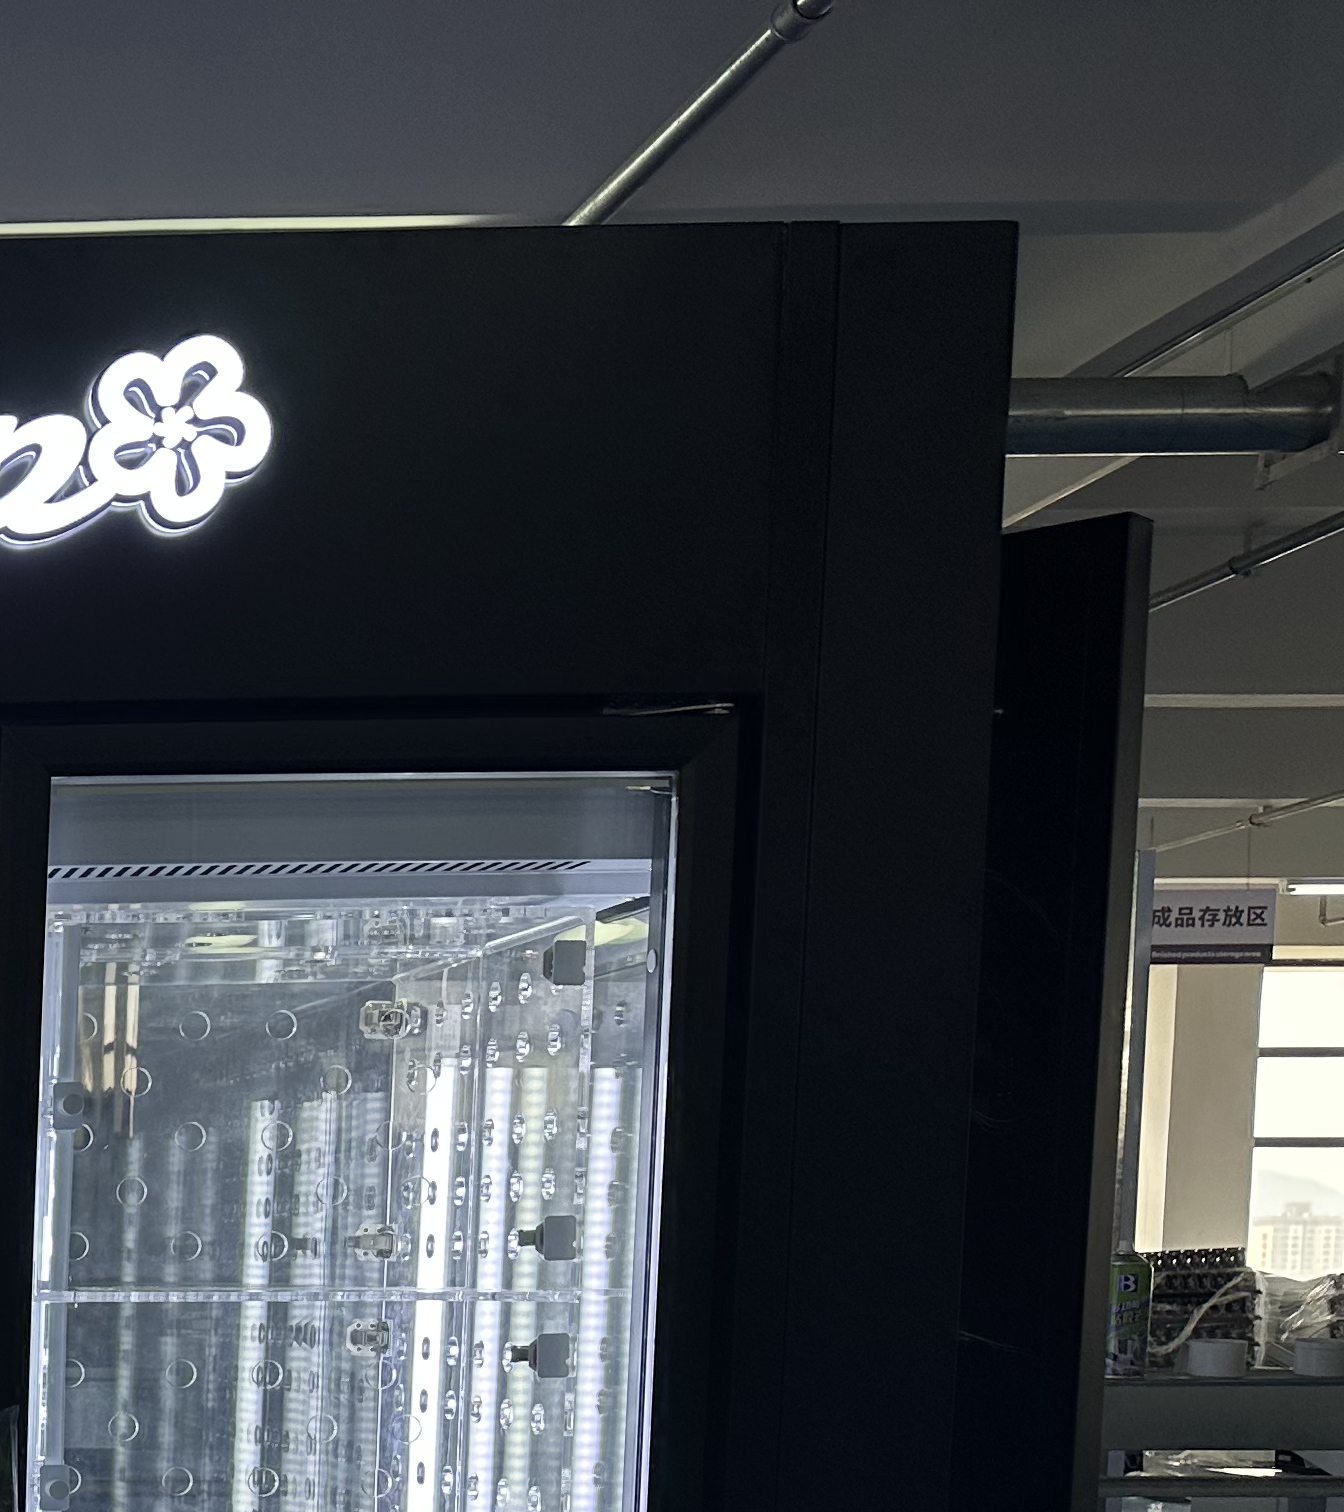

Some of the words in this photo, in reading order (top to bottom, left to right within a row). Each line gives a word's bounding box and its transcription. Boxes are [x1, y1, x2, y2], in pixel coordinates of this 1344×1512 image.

[1151, 905, 1268, 929] 成品存放区
[1118, 1274, 1137, 1293] B
